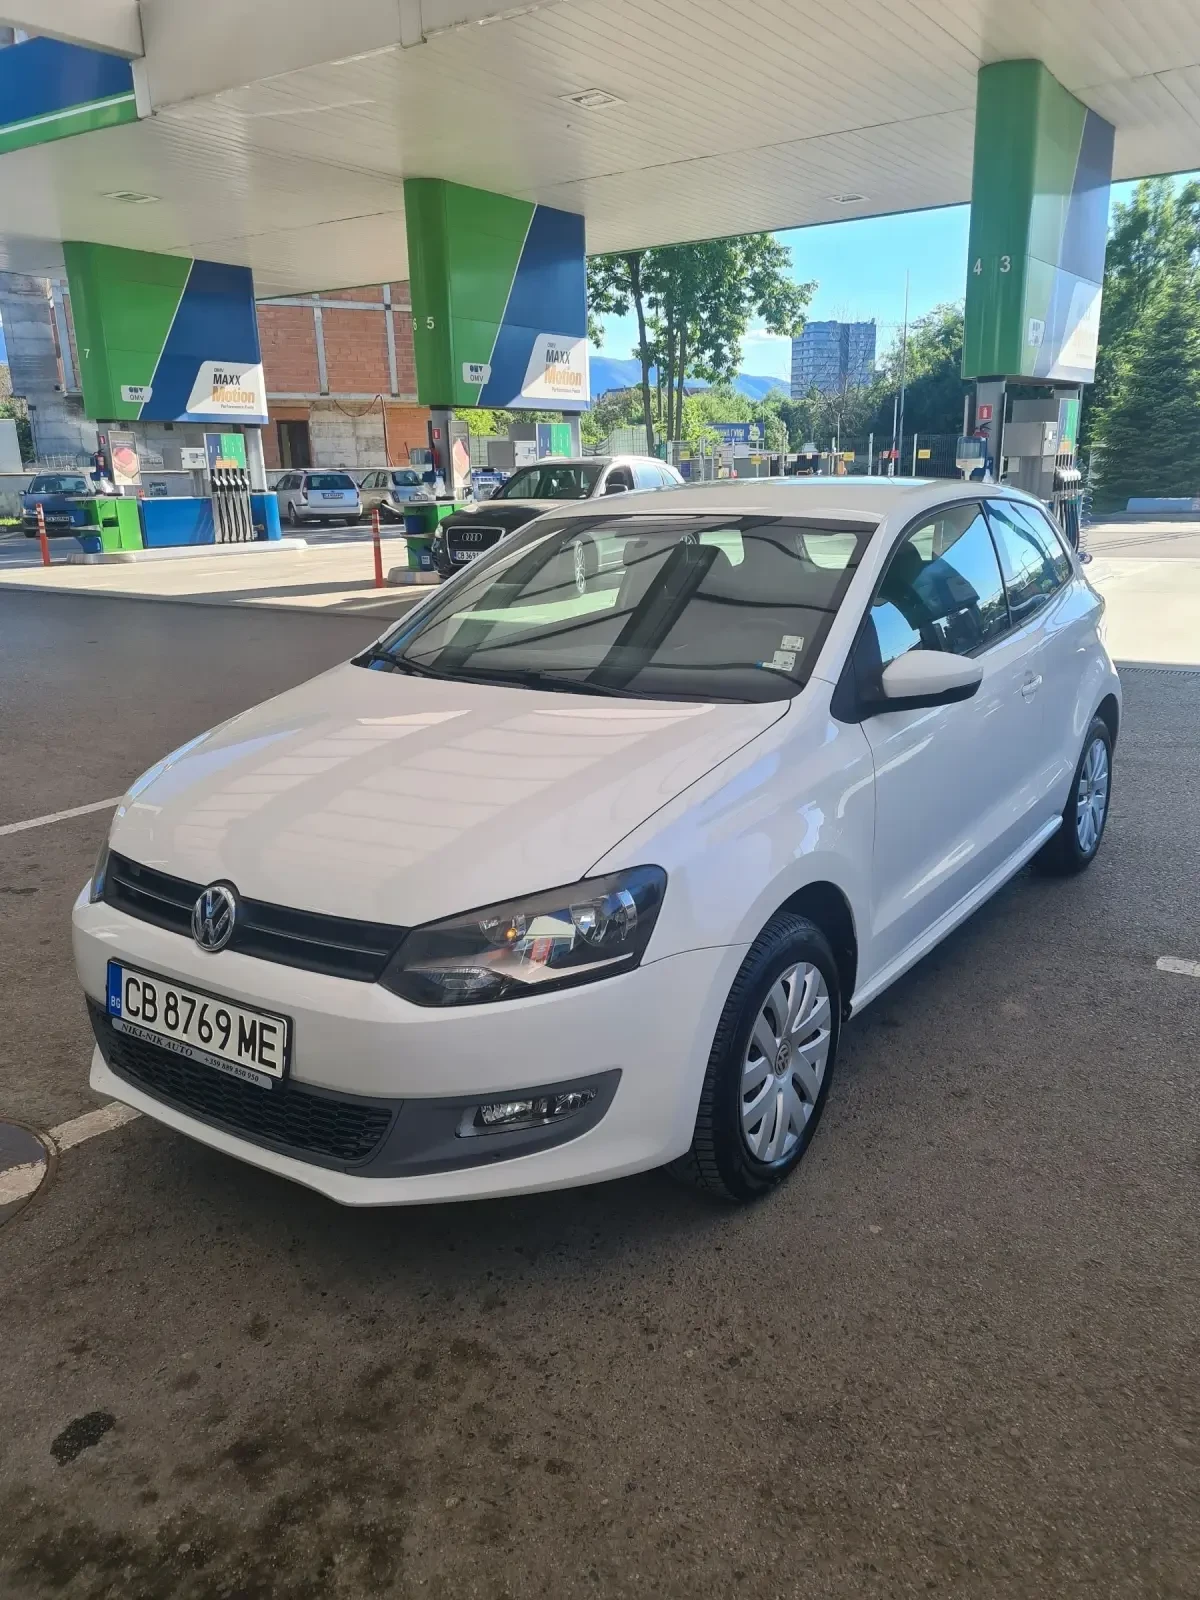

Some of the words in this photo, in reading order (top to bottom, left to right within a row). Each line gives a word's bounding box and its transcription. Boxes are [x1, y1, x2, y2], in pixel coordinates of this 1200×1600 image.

[973, 258, 982, 275] 4
[1000, 255, 1011, 273] 3
[426, 316, 435, 330] 5
[84, 348, 90, 359] 7
[546, 349, 571, 364] MAXX
[213, 374, 241, 386] MAXX
[470, 374, 484, 382] OMV
[544, 364, 582, 386] Motion
[212, 386, 256, 404] Motion
[110, 995, 120, 1009] BG
[125, 977, 158, 1023] CB
[164, 991, 232, 1050] 8769
[238, 1015, 277, 1070] ME
[121, 1023, 163, 1046] NIKI-NIK
[164, 1040, 193, 1057] AUTO
[204, 1057, 220, 1068] +359
[248, 1072, 259, 1082] 950
